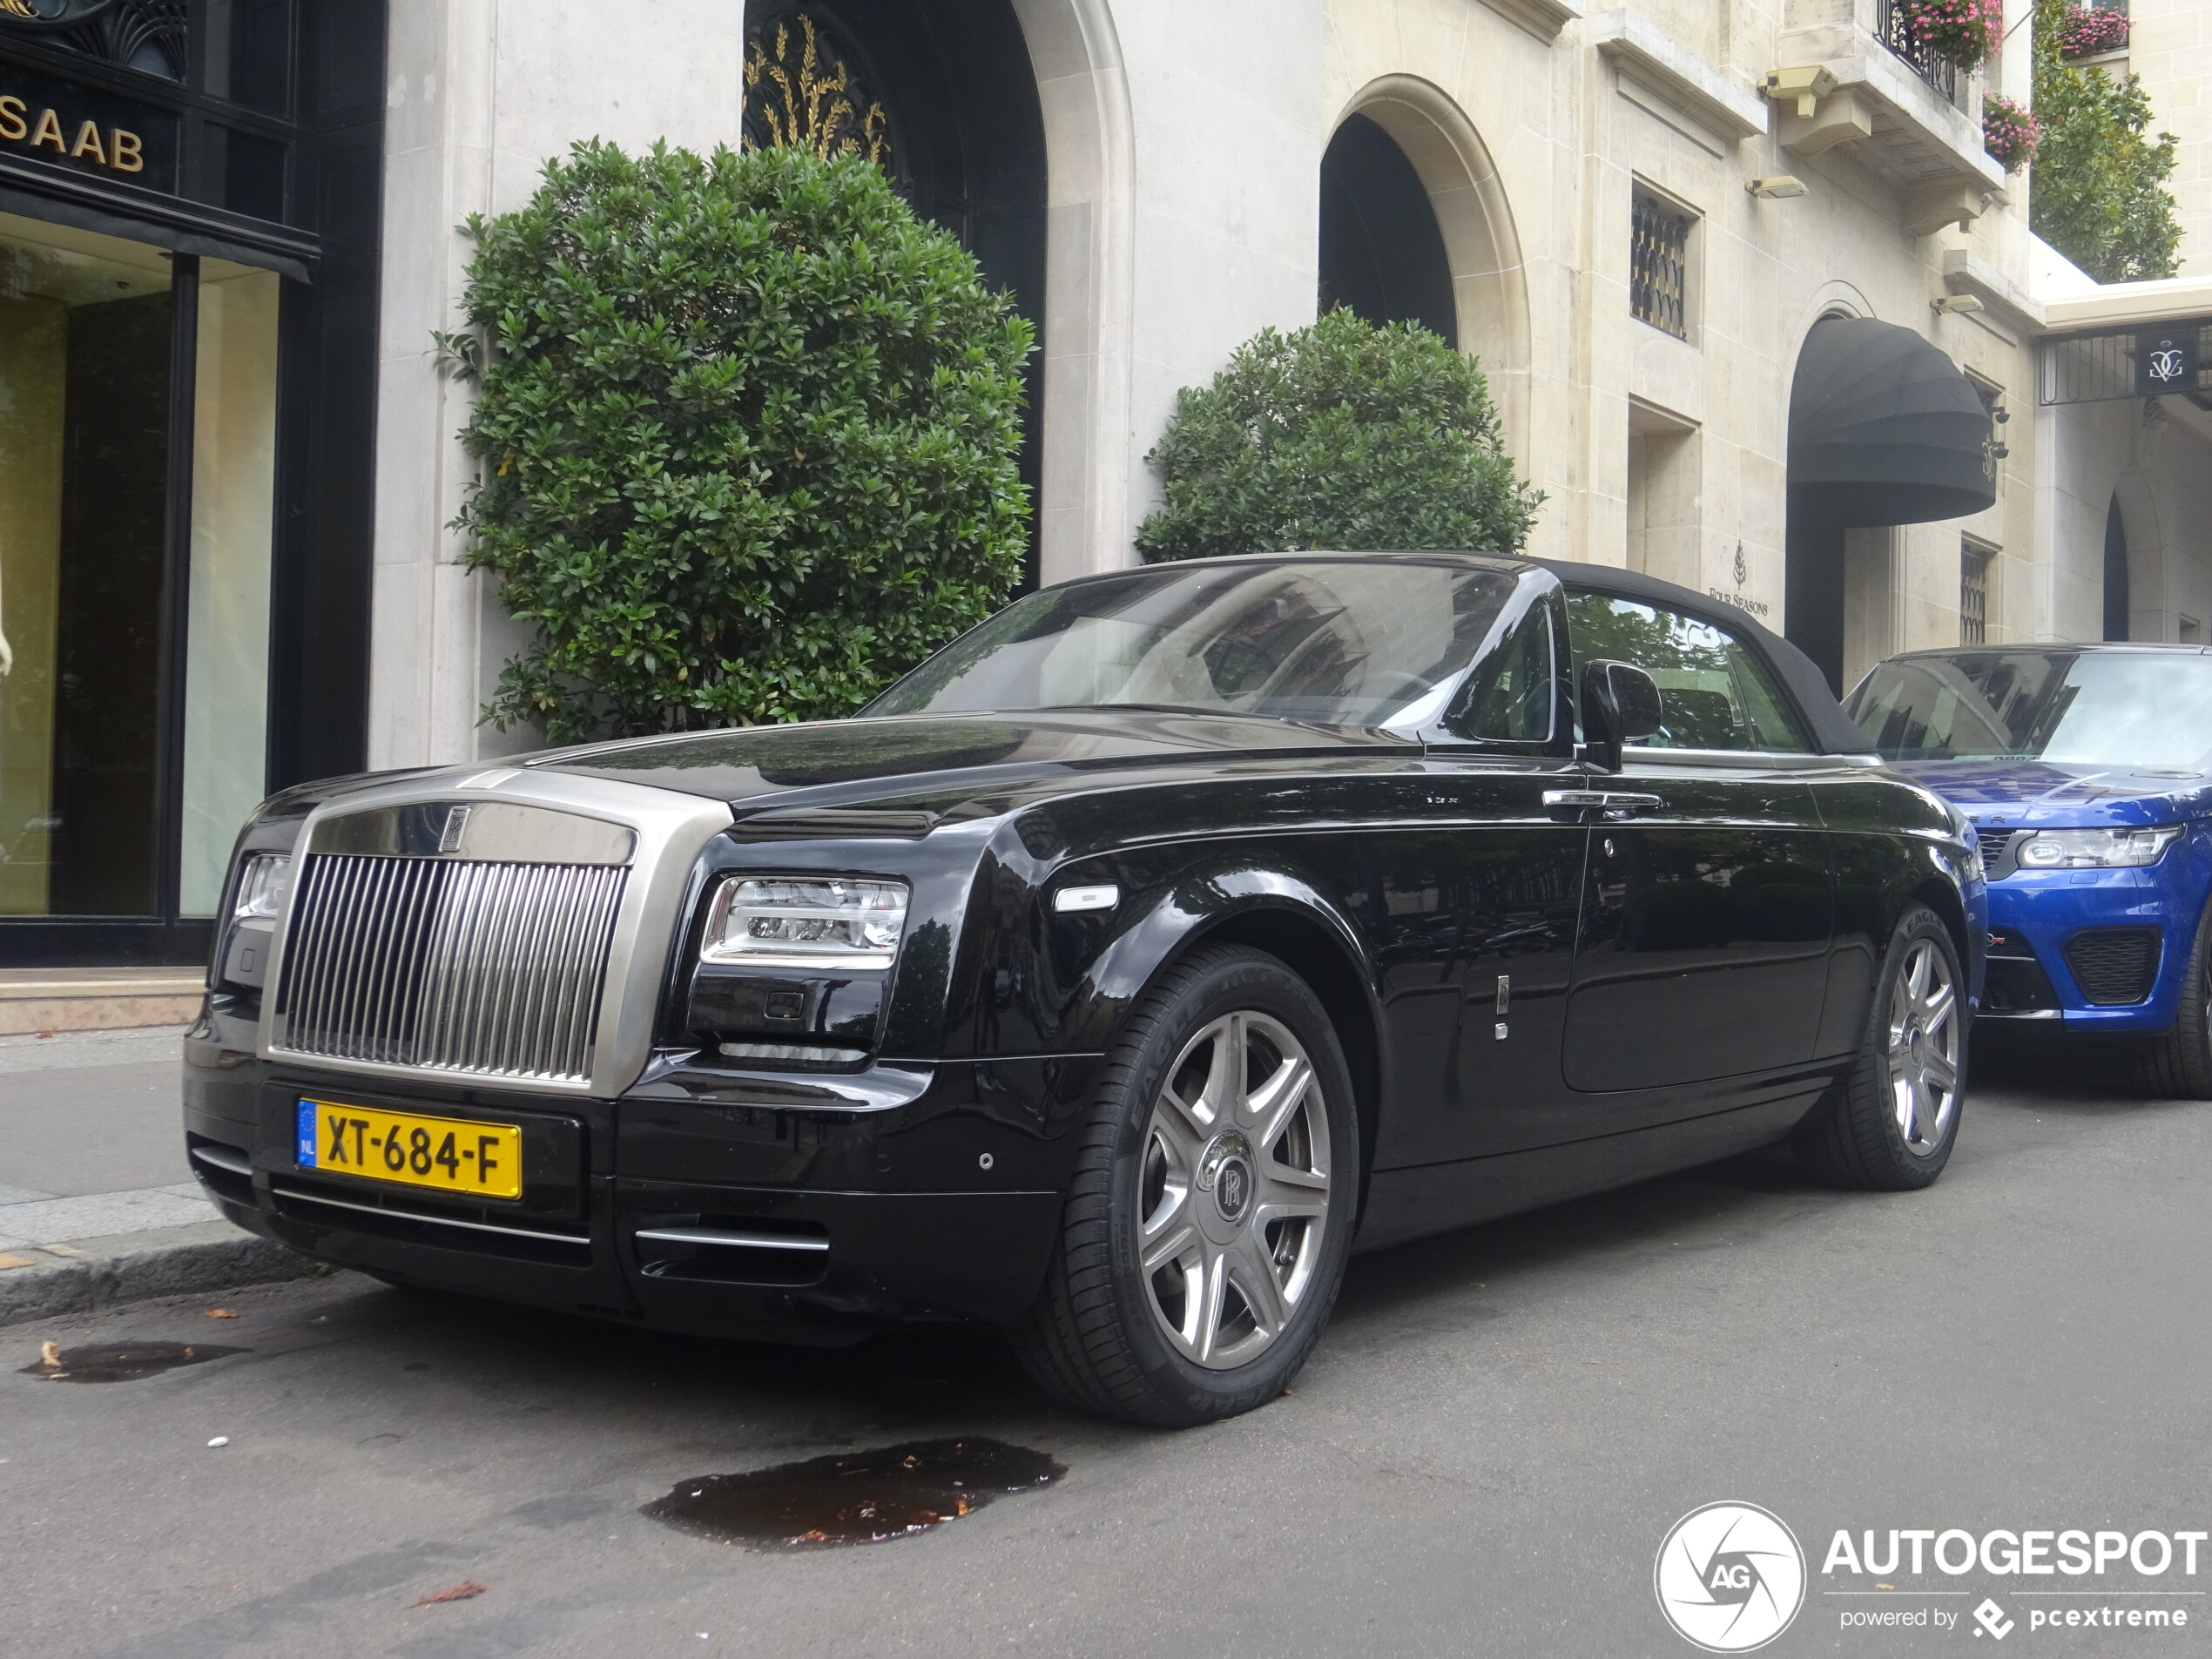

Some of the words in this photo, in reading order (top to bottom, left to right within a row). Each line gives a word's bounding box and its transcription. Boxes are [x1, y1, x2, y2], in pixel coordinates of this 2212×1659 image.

[0, 95, 144, 172] SAAB
[301, 1140, 314, 1155] NL
[327, 1115, 499, 1183] XT-684-F
